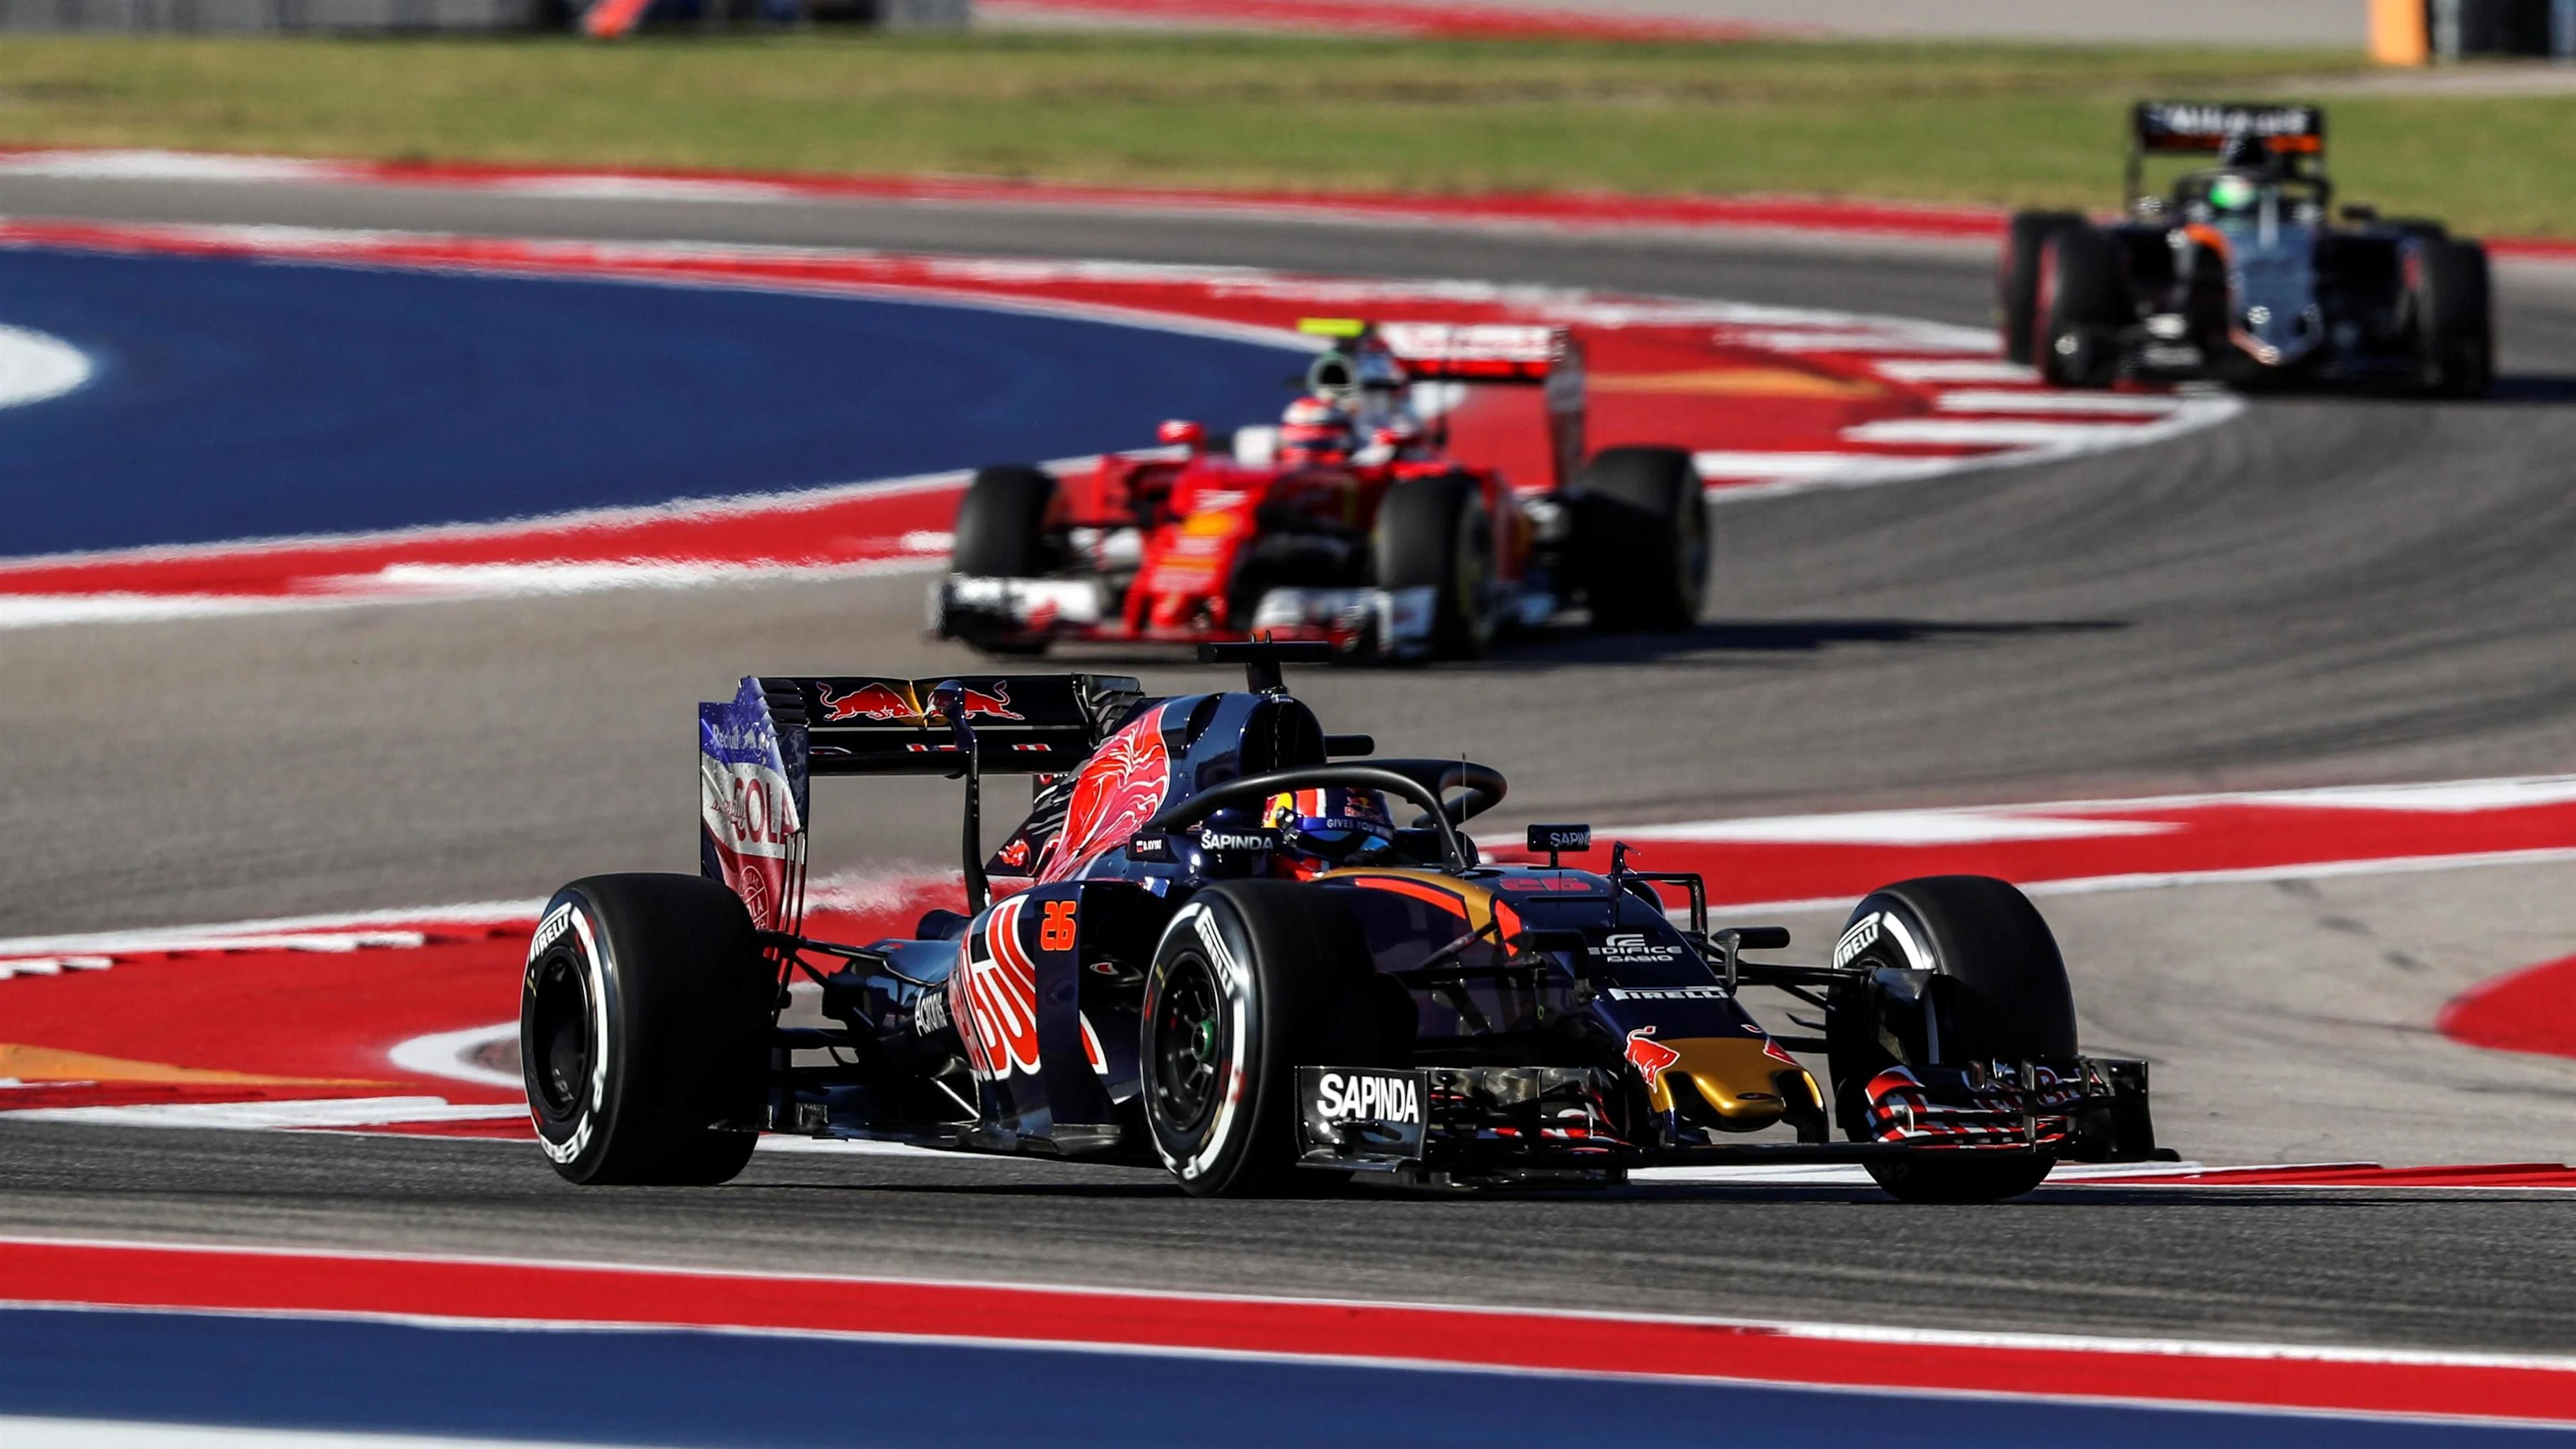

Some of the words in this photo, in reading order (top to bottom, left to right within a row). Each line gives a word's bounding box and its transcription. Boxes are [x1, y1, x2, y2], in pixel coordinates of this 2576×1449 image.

[734, 778, 795, 844] COLA
[1327, 819, 1354, 829] GIVES
[1201, 834, 1274, 850] SAPINDA
[530, 902, 572, 963] PIRELLI
[1041, 900, 1076, 951] 26
[1833, 911, 1880, 969] PIRELLI
[1587, 946, 1682, 956] EDIFICE
[1607, 955, 1674, 963] CASIO
[1608, 985, 1729, 1001] PIRELLI
[1317, 1073, 1420, 1124] SAPINDA
